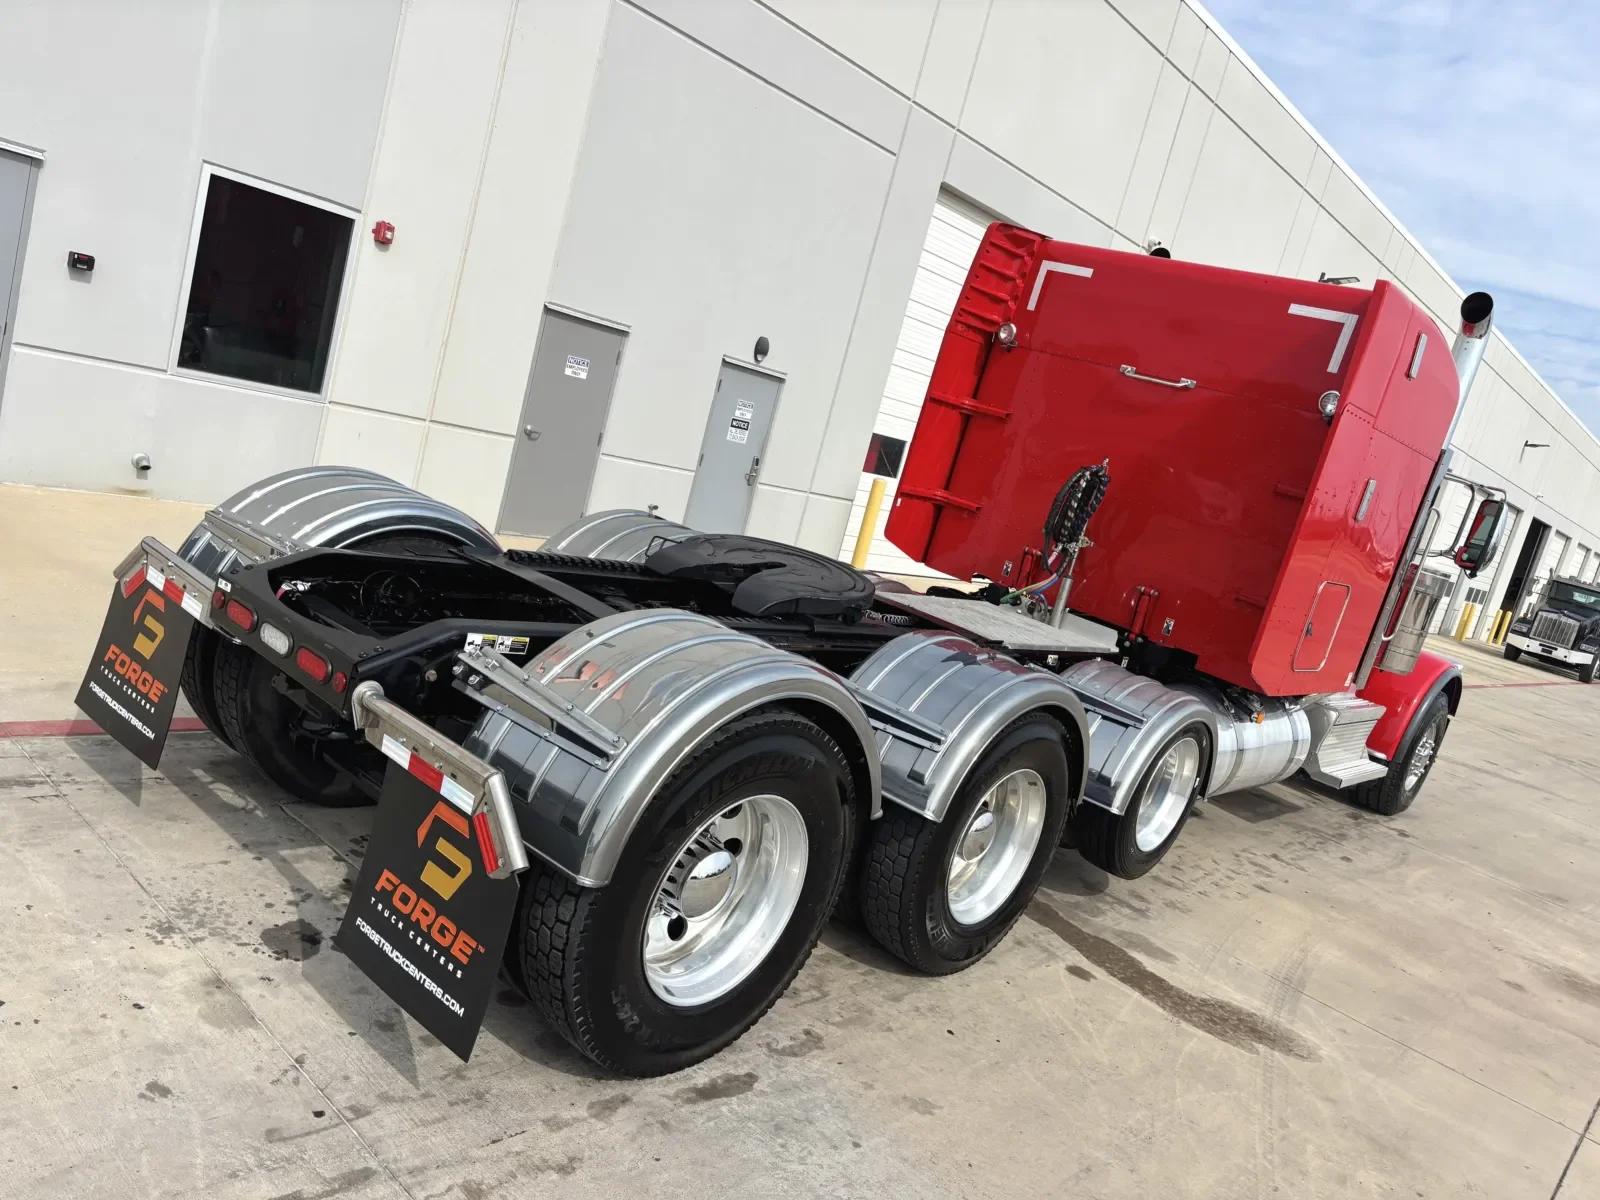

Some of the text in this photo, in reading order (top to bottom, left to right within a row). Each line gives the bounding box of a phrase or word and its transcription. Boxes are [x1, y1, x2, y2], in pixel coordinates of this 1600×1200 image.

[732, 420, 748, 429] NOTICE
[89, 681, 155, 740] FORGETRUCKCENTERS.COM
[100, 665, 155, 714] TRUCK CENTERS
[355, 916, 465, 1018] FORGETRUCKCENTERS.COM
[370, 896, 463, 979] TRUCK CENTERS
